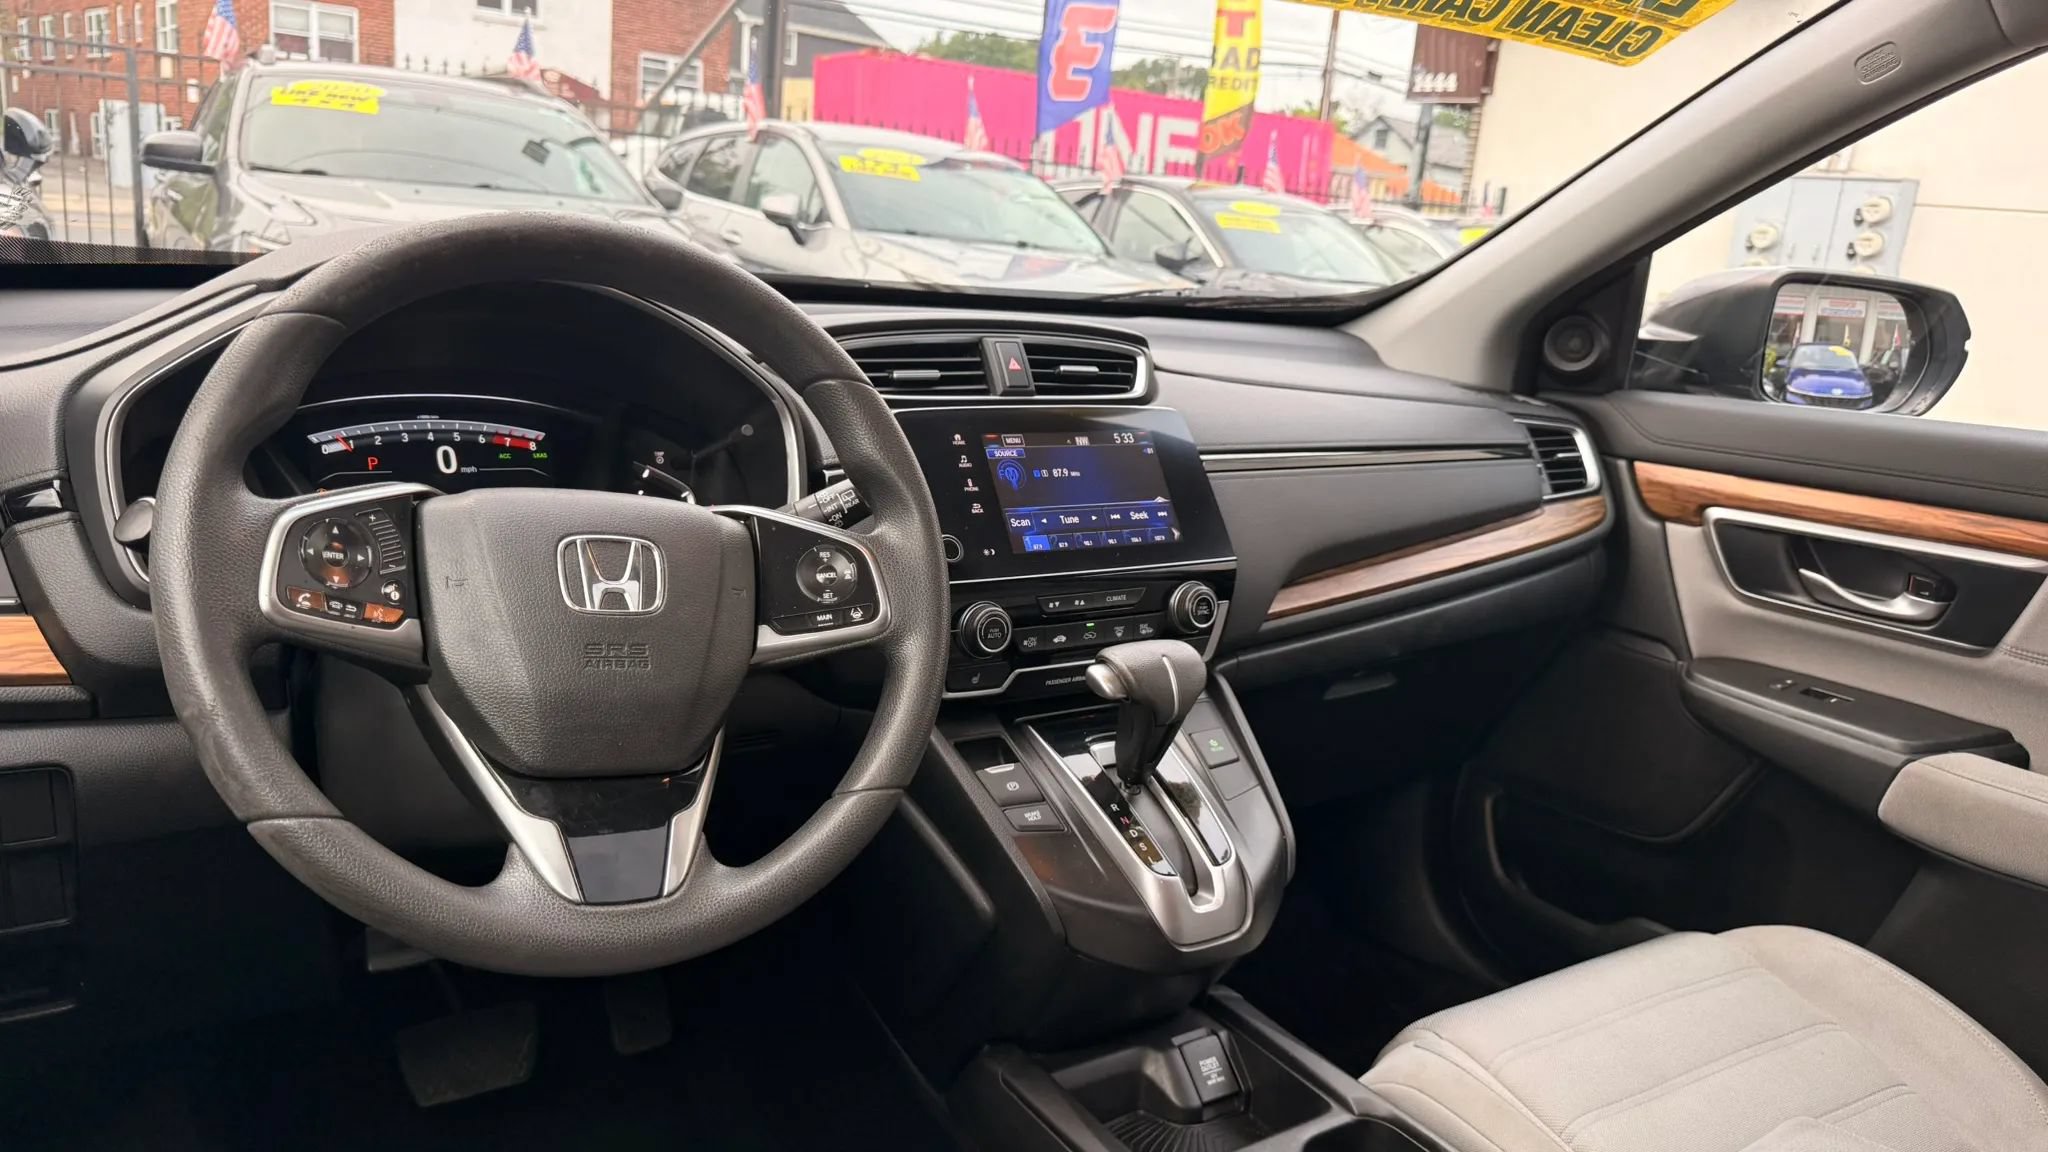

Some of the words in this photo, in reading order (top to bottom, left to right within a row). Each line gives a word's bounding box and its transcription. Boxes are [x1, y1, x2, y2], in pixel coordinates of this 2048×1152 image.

[1211, 46, 1261, 72] AD
[374, 435, 382, 446] 2
[401, 433, 409, 443] 3
[427, 431, 435, 442] 4
[453, 431, 461, 442] 5
[478, 434, 486, 444] 6
[504, 436, 512, 448] 7
[529, 440, 538, 451] 8
[993, 449, 1018, 457] SOURCE
[367, 456, 379, 471] P
[436, 445, 458, 475] 0
[1052, 468, 1069, 477] 87.9
[1059, 515, 1080, 525] Tune
[1129, 511, 1149, 520] Seek
[1010, 518, 1031, 527] Scan
[322, 551, 344, 560] ENTER
[1106, 594, 1127, 602] CLIMATE
[585, 644, 651, 657] SRS
[584, 659, 652, 671] AIRBAG
[1110, 803, 1120, 811] R
[1120, 816, 1130, 825] N
[1129, 829, 1139, 838] D
[1139, 842, 1148, 852] S
